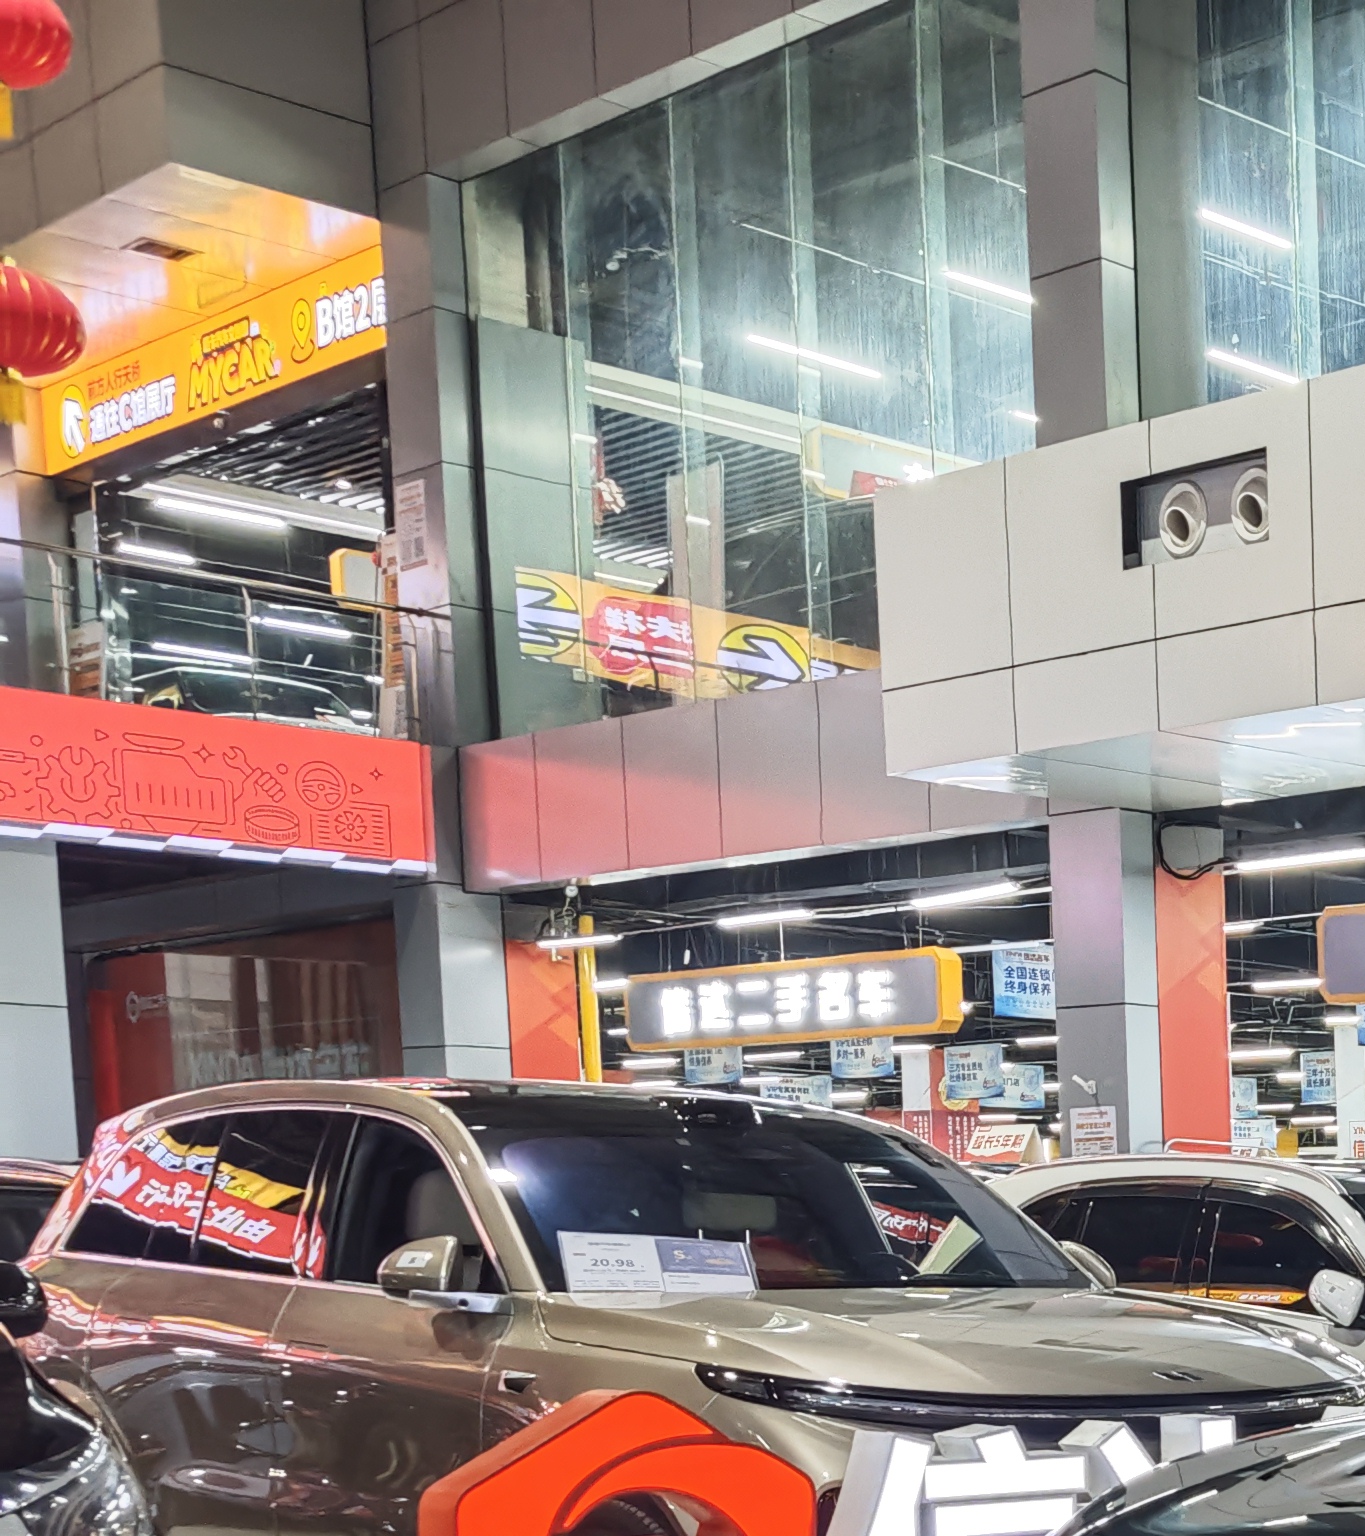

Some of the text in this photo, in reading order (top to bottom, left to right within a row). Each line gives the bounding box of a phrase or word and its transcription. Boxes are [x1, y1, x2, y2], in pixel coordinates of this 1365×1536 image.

[188, 336, 278, 412] MYCAR
[1004, 980, 1052, 997] 终身保养
[1306, 1068, 1336, 1078] 三年十万公
[590, 1257, 636, 1268] 20.98
